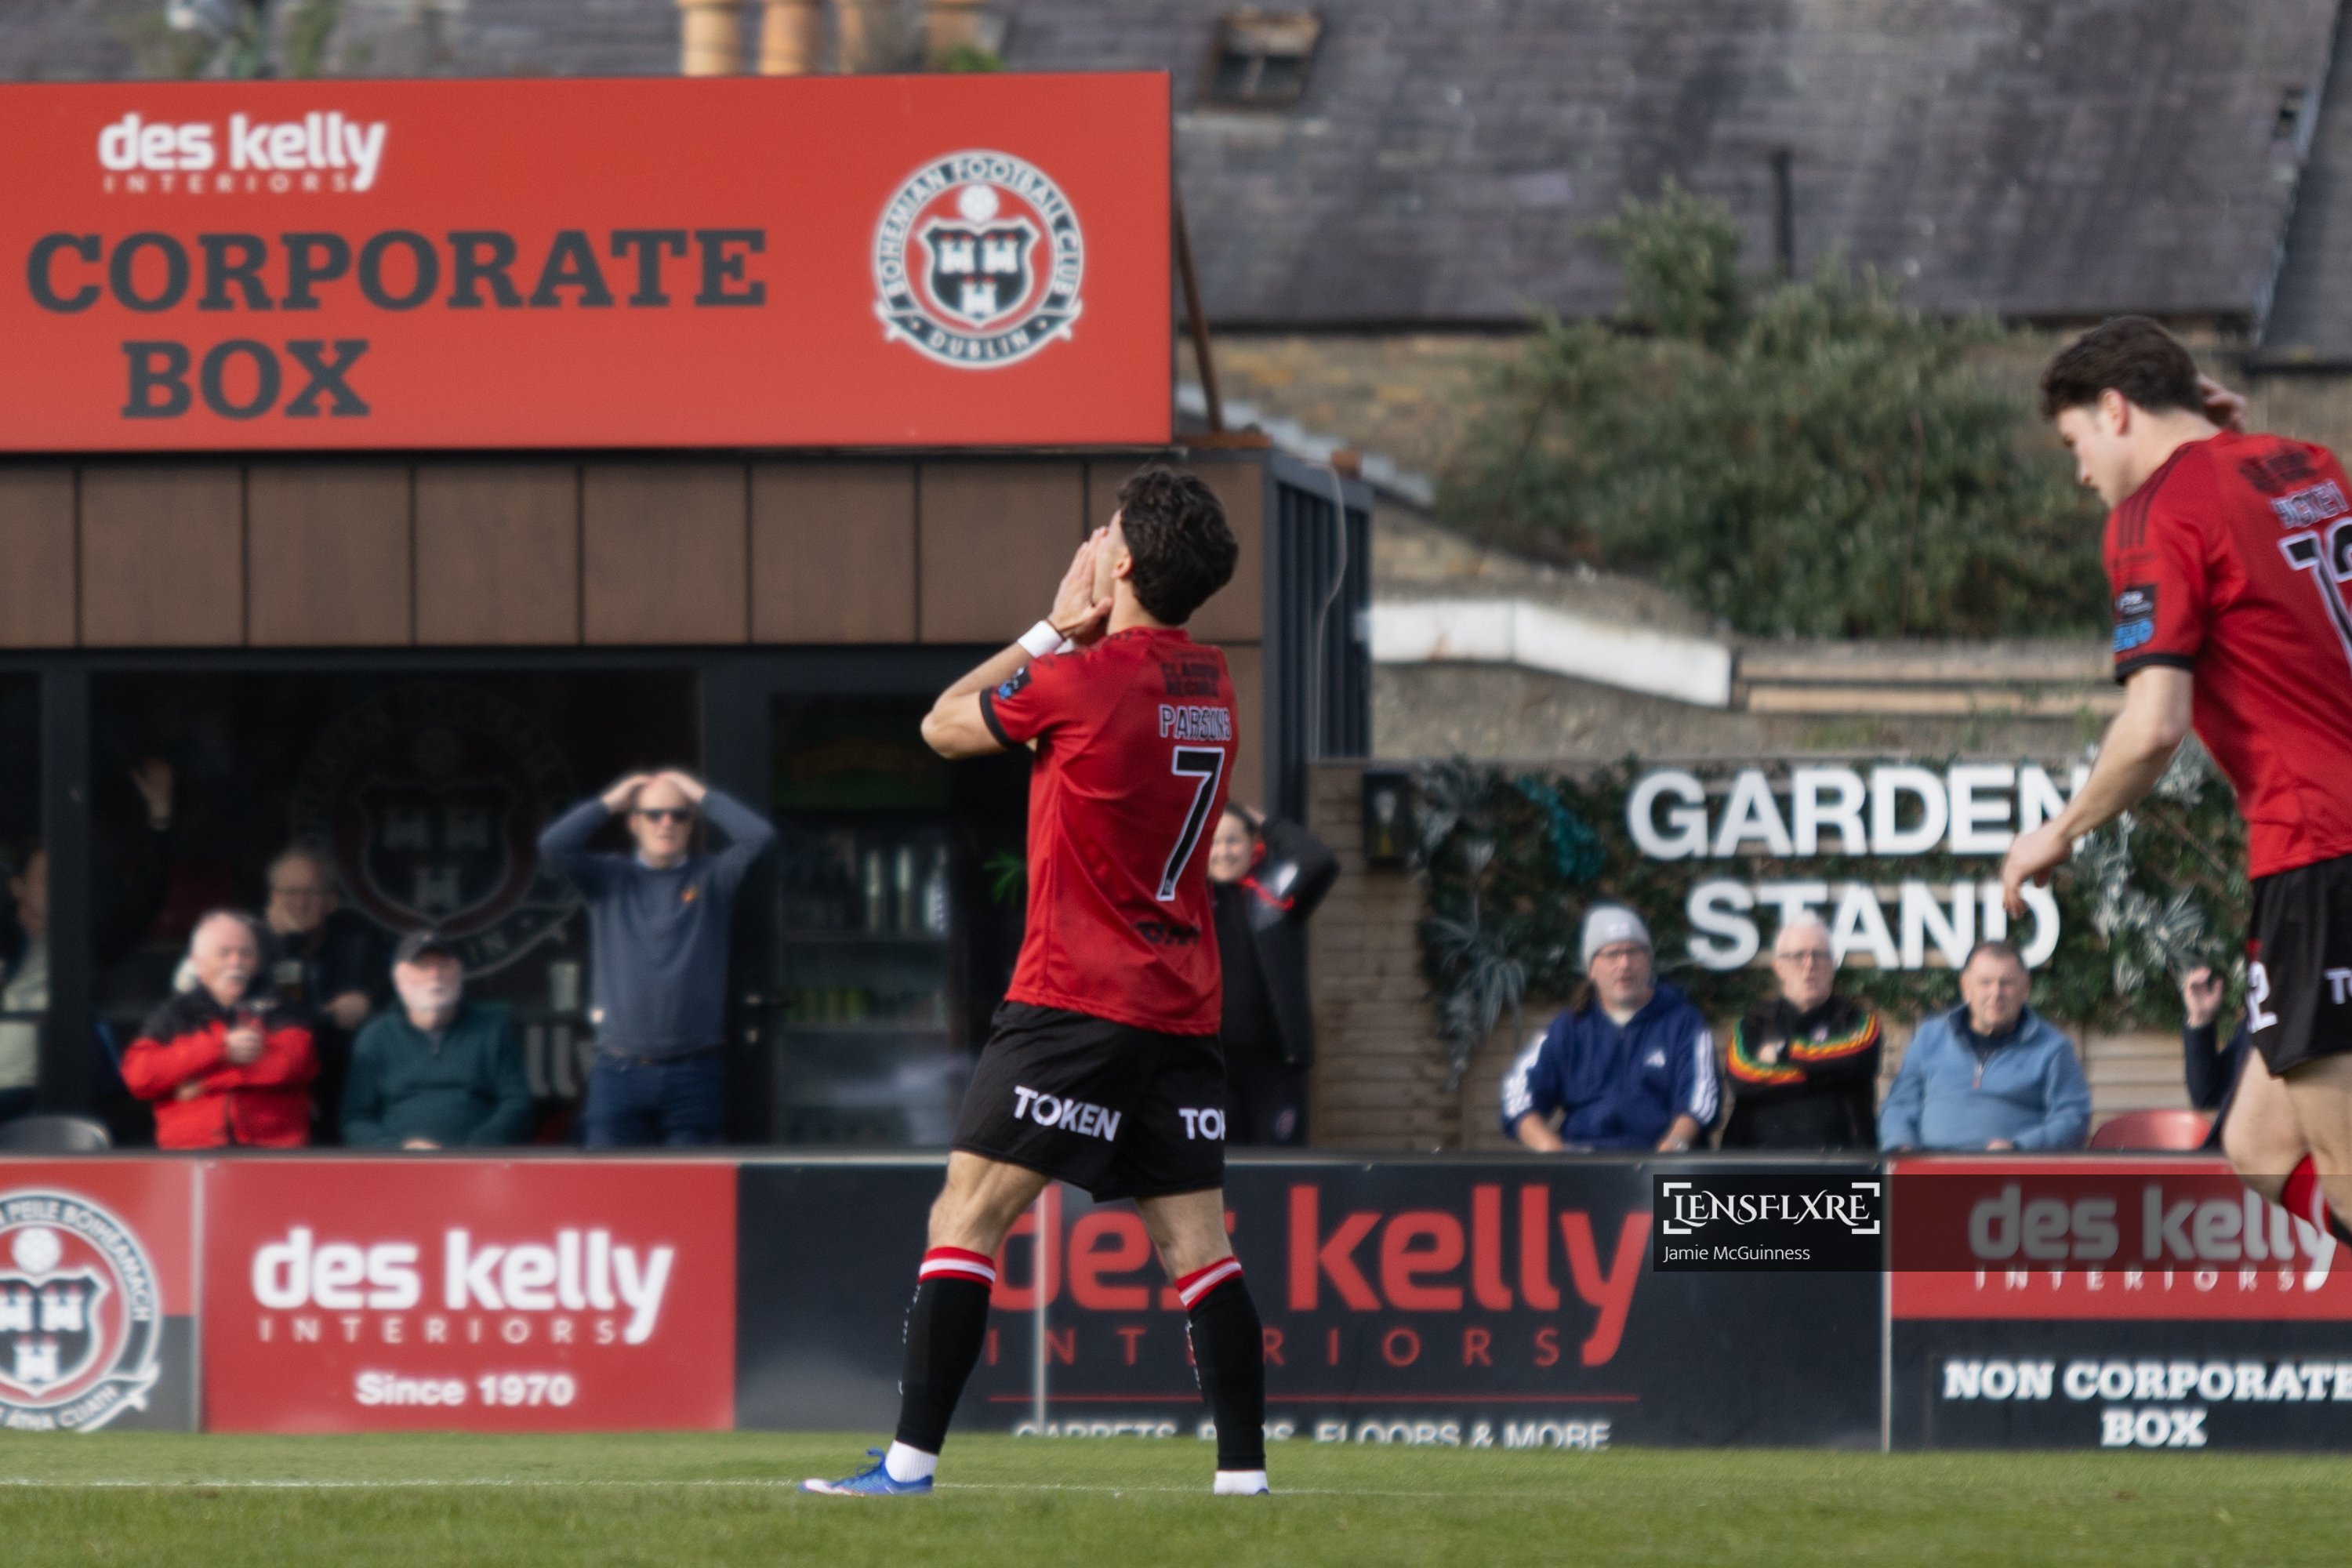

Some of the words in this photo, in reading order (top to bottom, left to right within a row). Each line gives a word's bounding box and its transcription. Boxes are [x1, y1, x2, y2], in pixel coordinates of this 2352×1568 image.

[99, 112, 214, 170] des
[230, 112, 387, 193] kelly
[104, 173, 347, 194] INTERIORS
[27, 230, 767, 314] CORPORATE
[930, 329, 1029, 358] DUBLIN
[121, 339, 370, 419] BOX
[1159, 704, 1232, 741] PARSONS
[1156, 746, 1225, 902] 7
[1628, 764, 2090, 859] GARDEN
[1686, 878, 2061, 970] STAND
[2324, 967, 2352, 1005] T
[1014, 1085, 1121, 1142] TOKEN
[1969, 1185, 2119, 1261] des
[2143, 1184, 2337, 1292] kelly
[252, 1226, 420, 1310] des
[445, 1229, 674, 1345] kelly
[1288, 1185, 1653, 1367] kelly
[1975, 1264, 2296, 1292] INTERIORS
[260, 1317, 613, 1343] INTERIORS
[985, 1328, 1562, 1367] INTRIORS
[355, 1372, 466, 1406] Since
[479, 1374, 575, 1406] 1970
[1944, 1360, 2056, 1401] NON
[2063, 1361, 2352, 1402] CORPORATE
[2101, 1407, 2209, 1448] BOX
